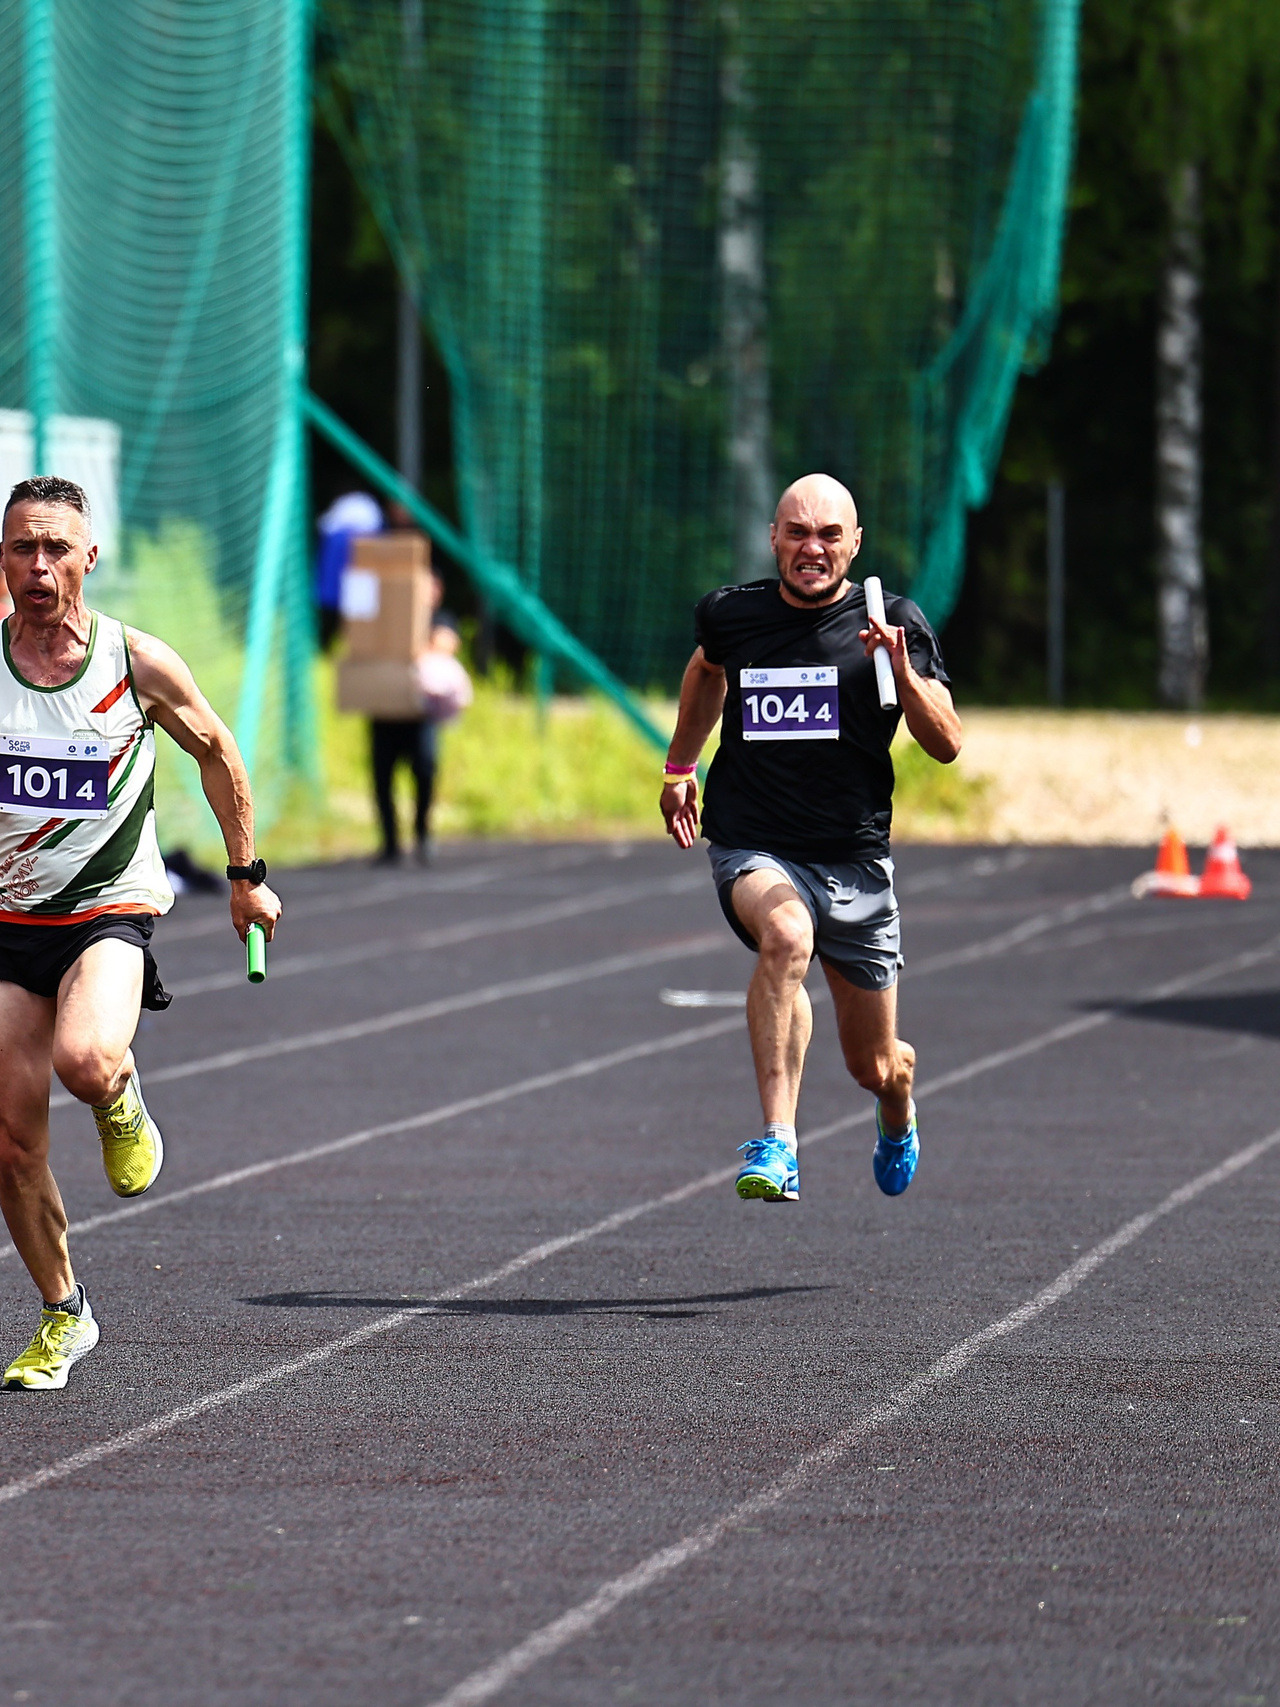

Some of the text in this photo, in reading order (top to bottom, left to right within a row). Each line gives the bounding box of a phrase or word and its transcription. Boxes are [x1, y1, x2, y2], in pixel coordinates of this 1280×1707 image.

[745, 694, 832, 723] 104 4
[6, 764, 96, 801] 101 4
